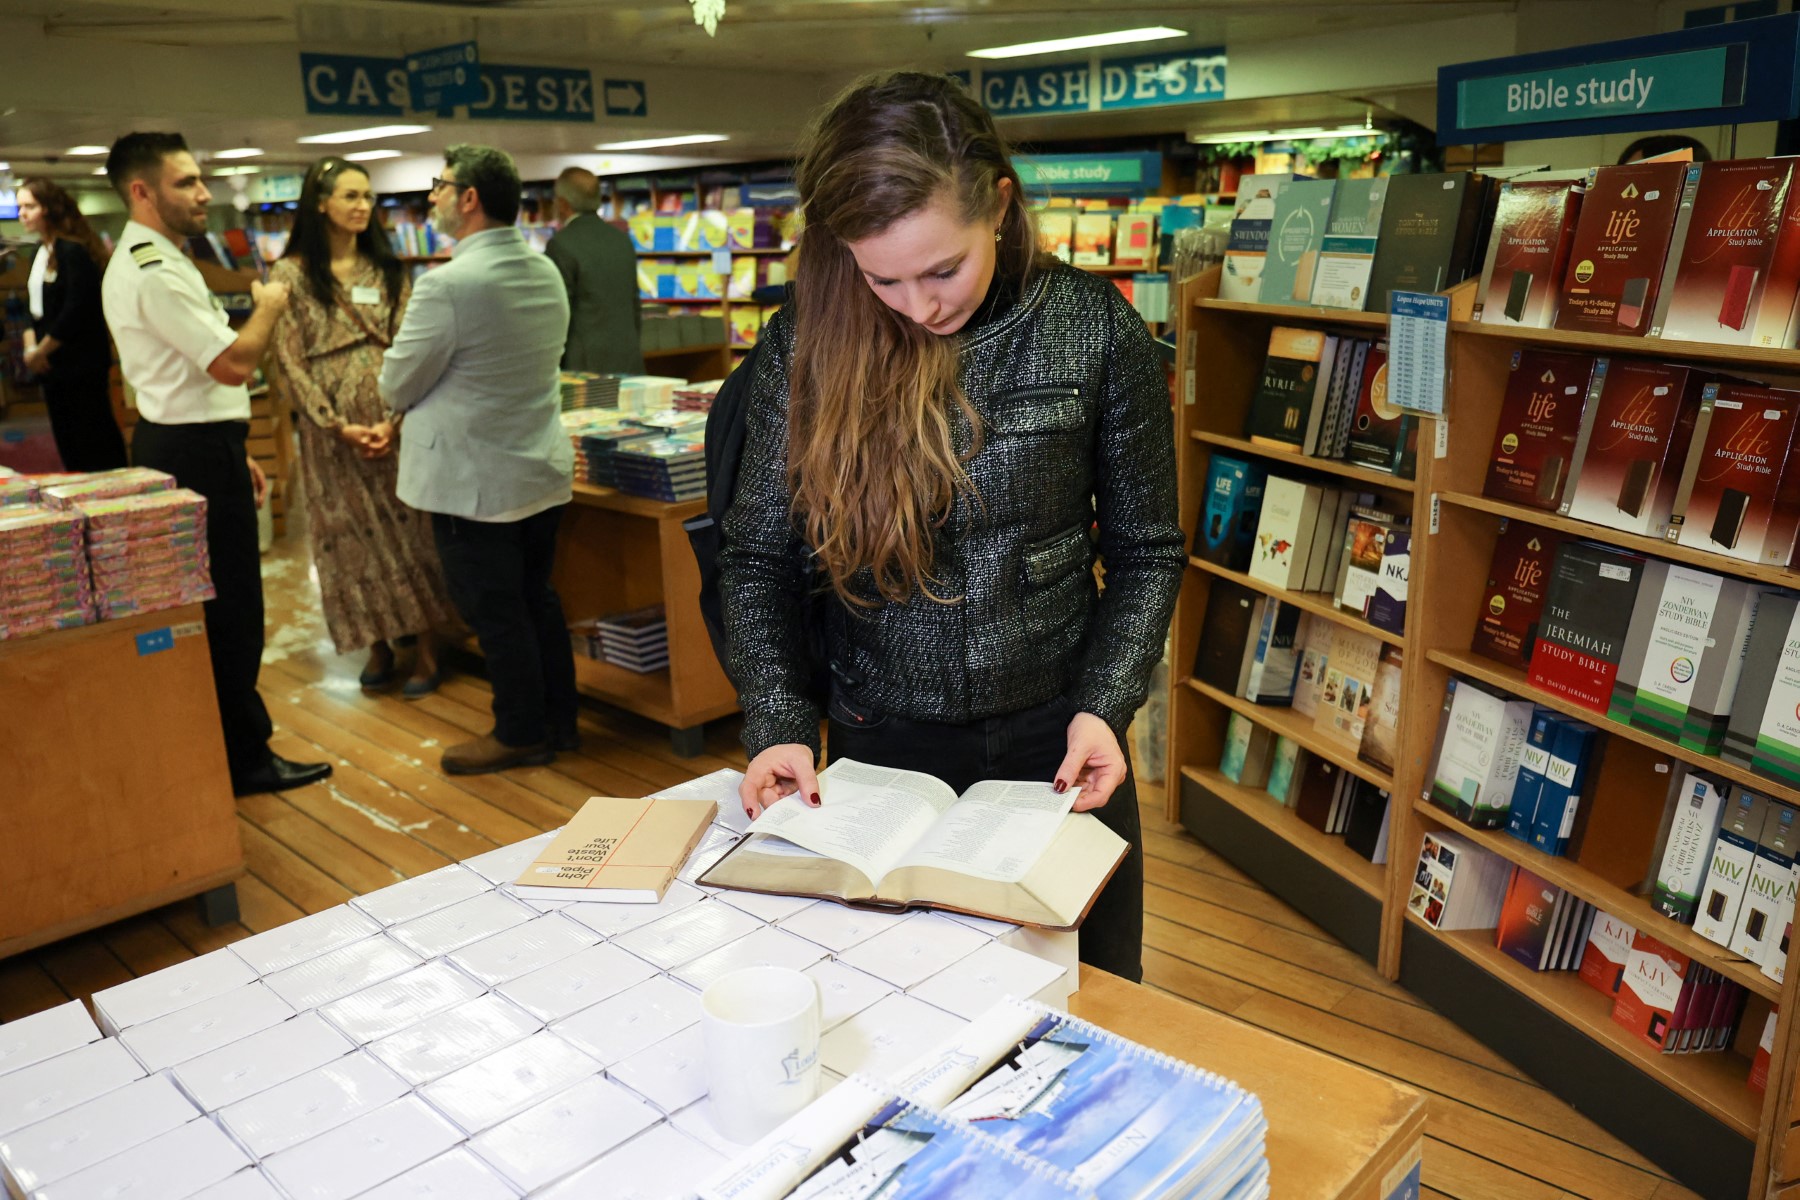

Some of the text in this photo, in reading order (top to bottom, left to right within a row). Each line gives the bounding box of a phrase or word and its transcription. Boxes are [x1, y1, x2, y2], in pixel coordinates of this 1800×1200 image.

[308, 65, 409, 107] CAS
[984, 56, 1225, 109] CASH DESK
[1507, 68, 1655, 113] Bible study
[1036, 165, 1112, 181] Bible study
[1331, 221, 1366, 234] WOMEN
[1605, 209, 1641, 246] life
[1707, 227, 1759, 237] APPLICATION
[1728, 239, 1746, 247] Study
[1264, 375, 1296, 391] RYRIE
[1528, 392, 1557, 423] life
[1610, 419, 1655, 434] APPLICATION
[1628, 431, 1659, 443] Study Bible
[1715, 448, 1768, 465] APPLICATION
[1736, 462, 1772, 475] Study Bible
[1215, 476, 1232, 491] LIFE
[1514, 558, 1542, 588] life
[1680, 596, 1696, 606] NIV
[1551, 605, 1571, 620] THE
[1662, 600, 1709, 620] ZONDERVAN
[1658, 609, 1709, 629] STUDY BIBLE
[1545, 623, 1613, 657] JEREMIAH
[1541, 643, 1608, 675] STUDY BIBLE
[1535, 674, 1600, 704] DR. DAVID JEREMIAH
[1524, 748, 1544, 765] NIV
[1551, 760, 1571, 778] NIV
[1696, 783, 1706, 791] NIV
[1676, 819, 1694, 874] STUDY BIBLE
[1682, 821, 1703, 878] ZONDERVAN
[556, 872, 590, 880] John
[1712, 855, 1744, 880] NIV
[1712, 871, 1740, 886] STUDY BIBLE
[1751, 873, 1784, 898] NIV
[1750, 888, 1780, 905] STUDY BIBLE
[1526, 907, 1543, 923] BIBLE
[1605, 920, 1634, 945] KJV
[1639, 960, 1671, 987] KJV
